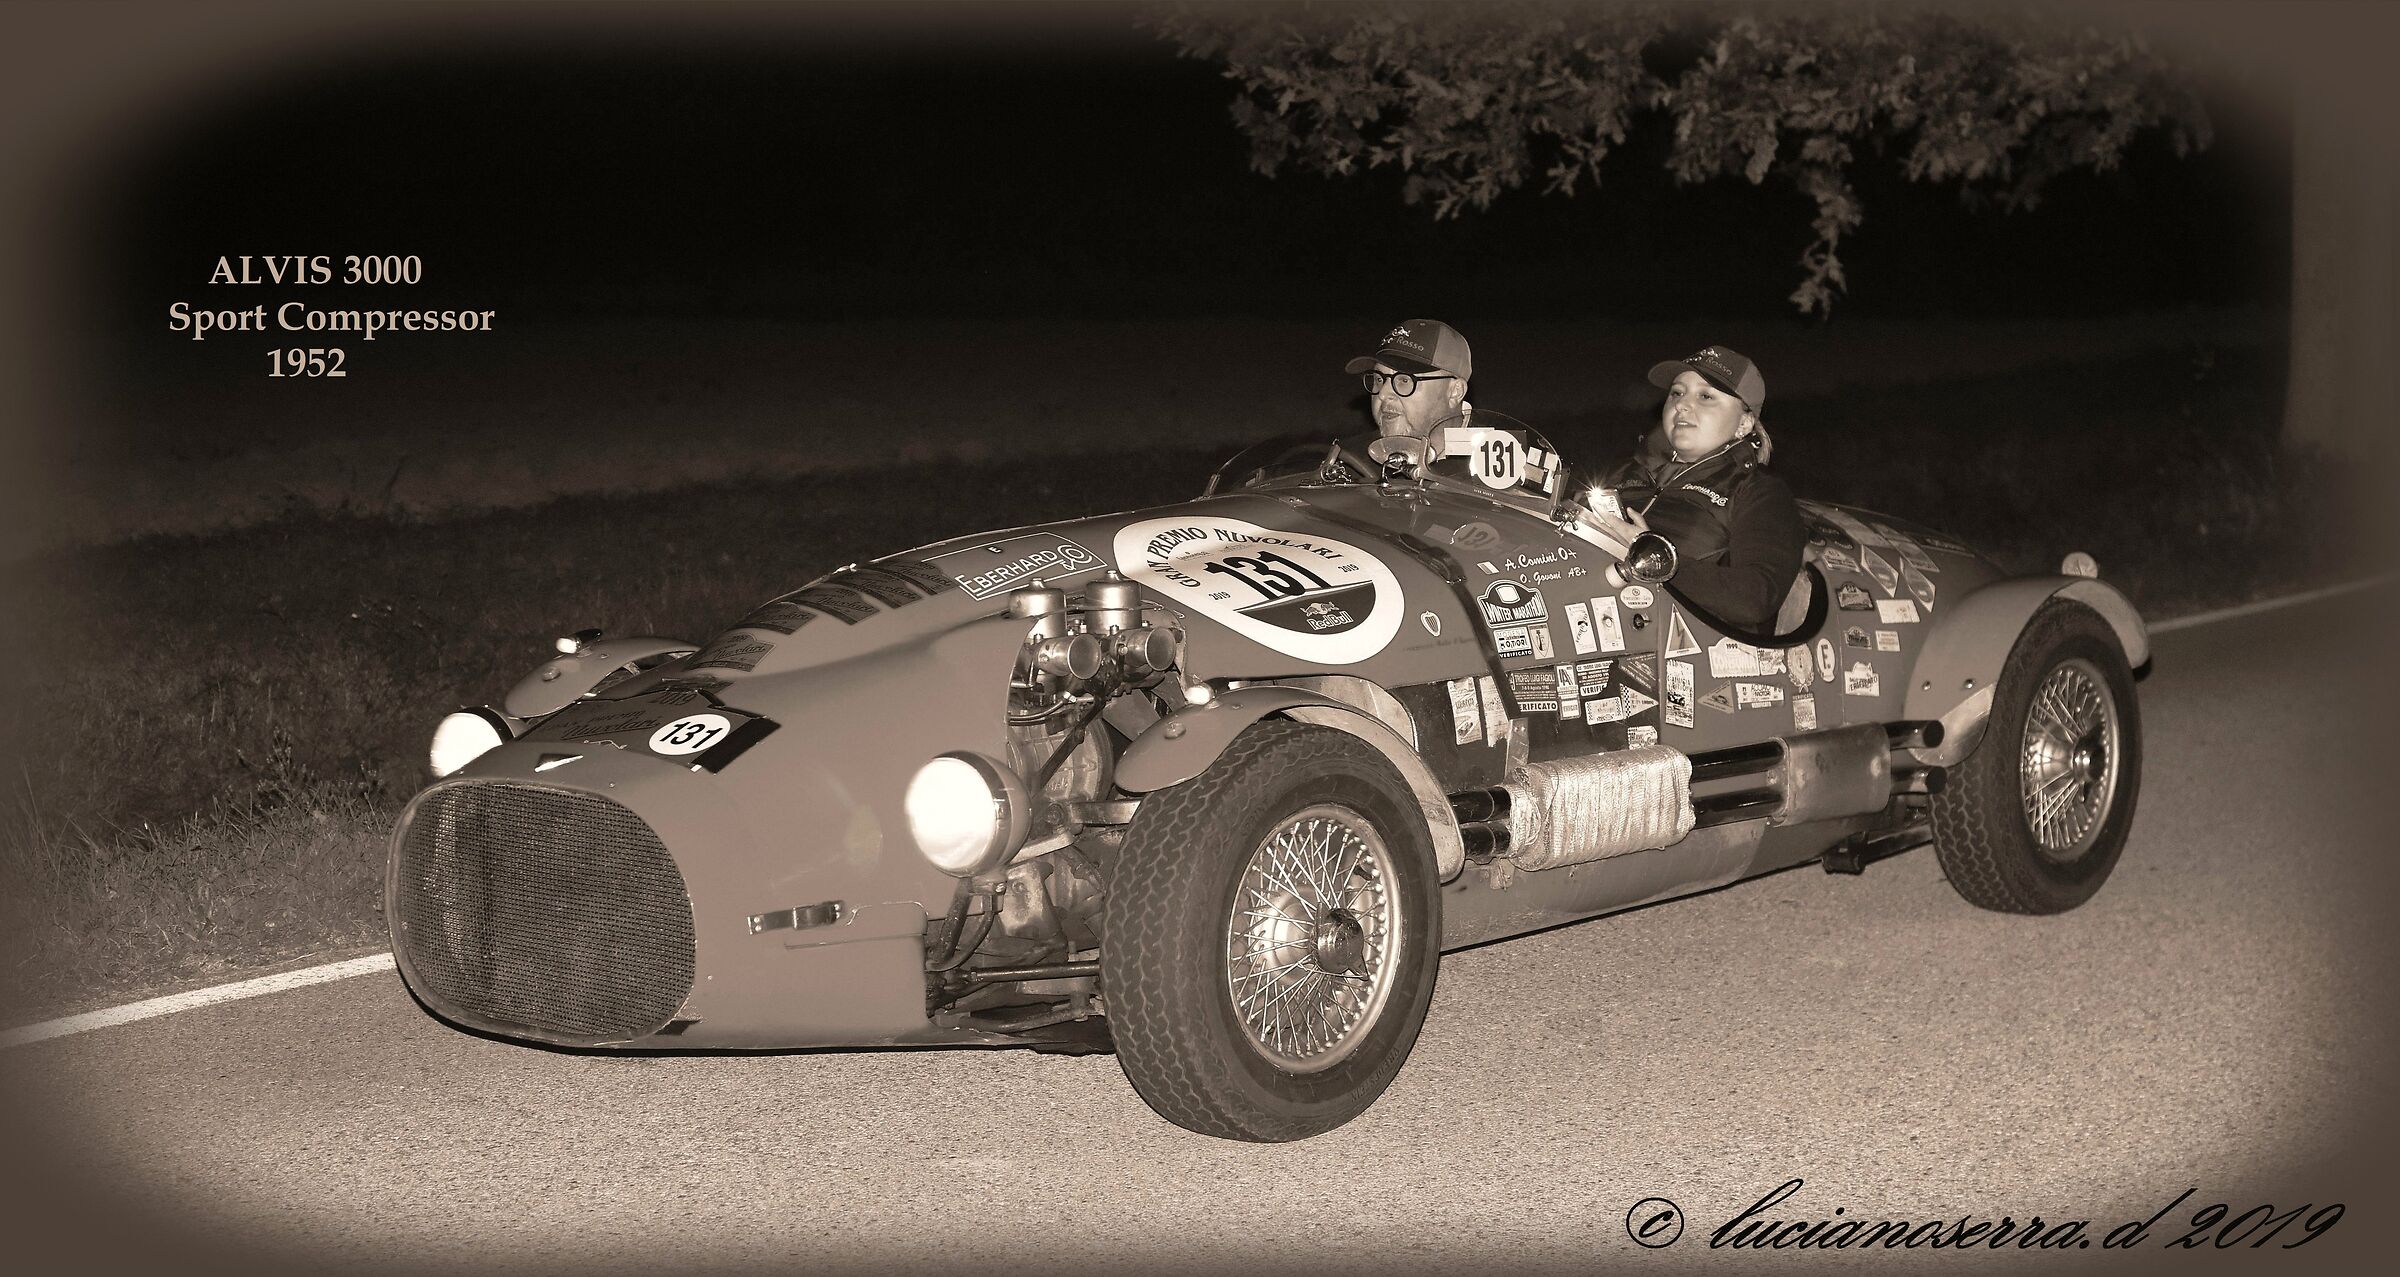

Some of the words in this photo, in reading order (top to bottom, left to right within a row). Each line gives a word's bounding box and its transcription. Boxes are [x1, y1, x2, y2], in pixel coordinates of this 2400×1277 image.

[1480, 440, 1514, 478] 131
[1146, 527, 1208, 560] PREMIO
[1213, 528, 1344, 559] NUVOLARI
[1557, 547, 1577, 561] O+
[954, 550, 1058, 594] EBERHARD
[1146, 559, 1201, 587] GRAN
[1203, 550, 1332, 601] 131
[1337, 563, 1360, 573] 2019
[1519, 573, 1531, 584] O.
[1567, 566, 1587, 578] AB+
[1208, 591, 1231, 601] 2019
[1481, 600, 1514, 623] WINTER
[1512, 592, 1546, 619] MARATHON
[1499, 650, 1532, 658] VERIFICATO
[1519, 702, 1557, 711] ERIFICATO
[659, 721, 724, 750] 131
